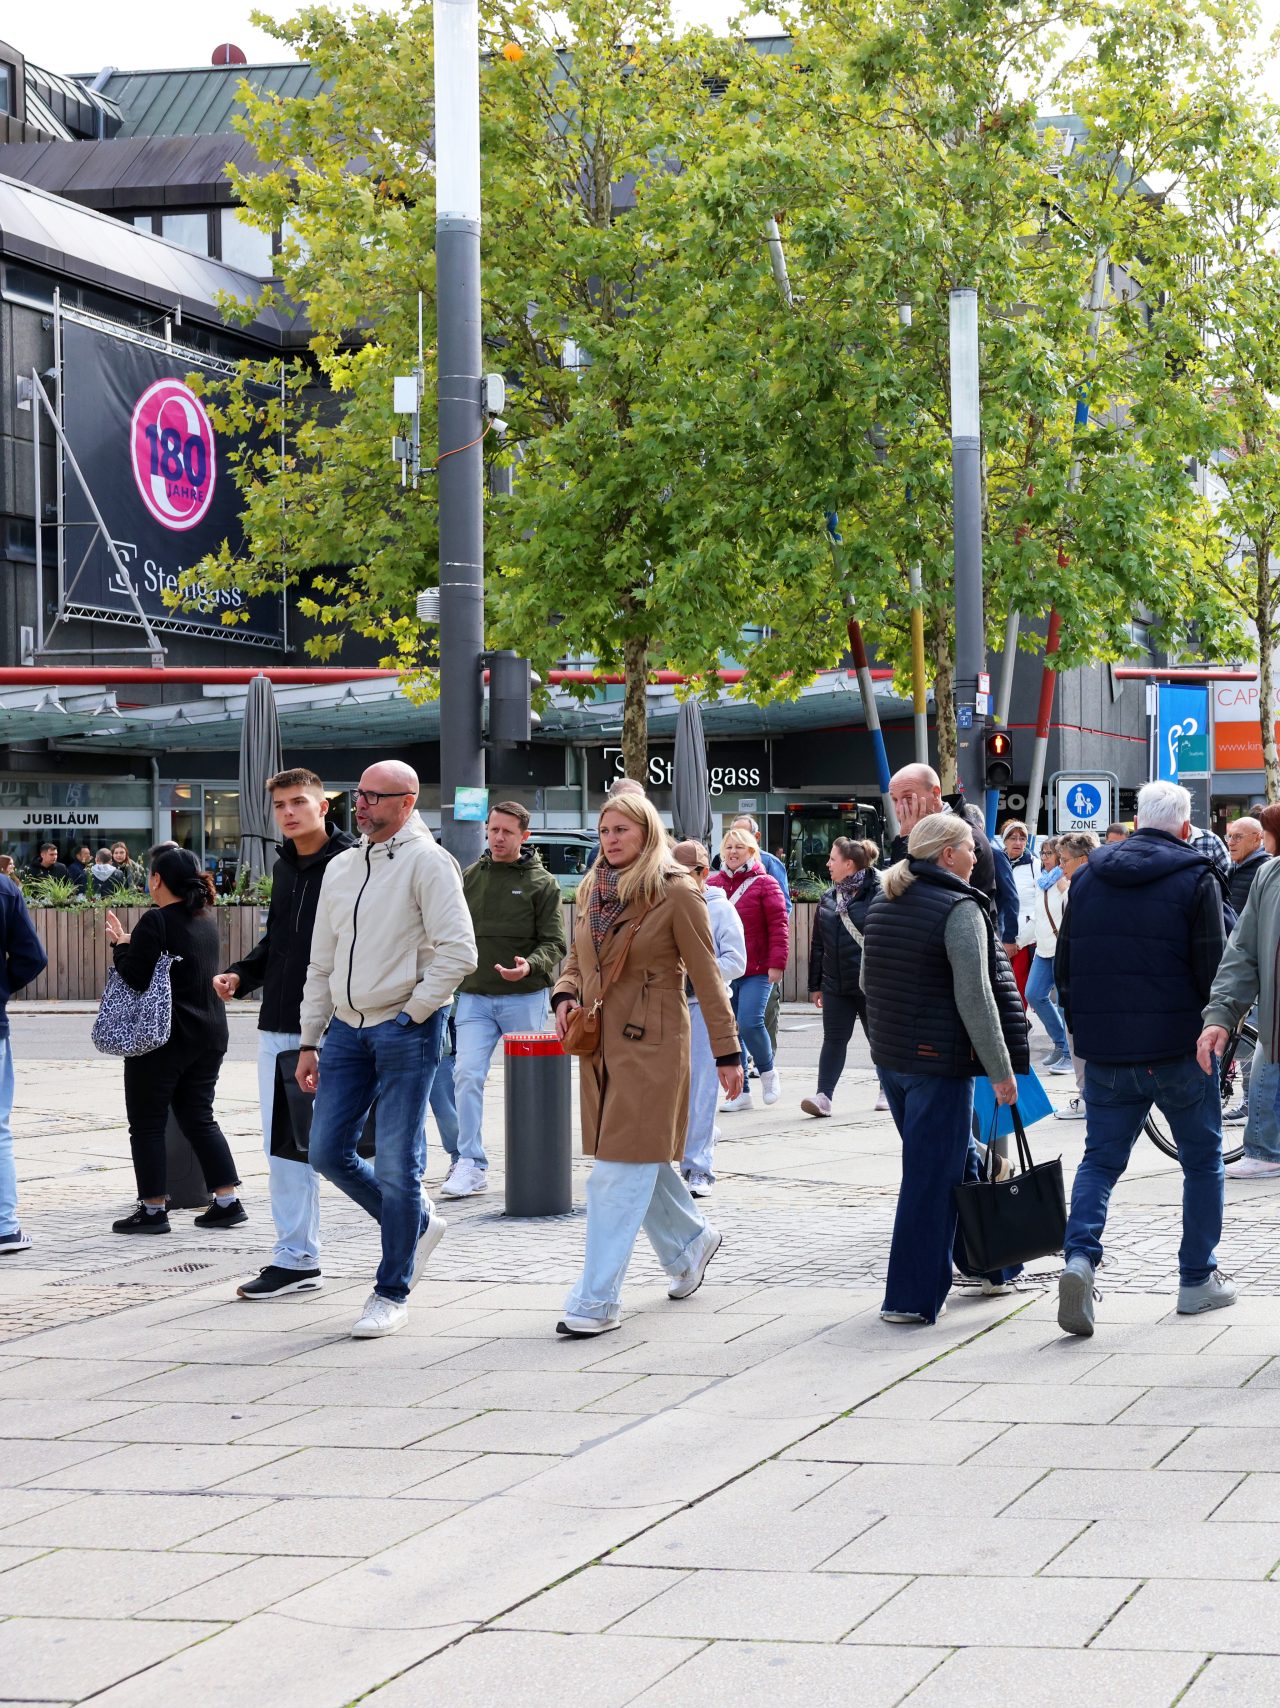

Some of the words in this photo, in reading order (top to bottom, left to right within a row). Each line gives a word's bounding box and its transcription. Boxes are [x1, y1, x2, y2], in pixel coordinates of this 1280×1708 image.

[145, 423, 207, 487] 180
[167, 483, 205, 503] JAHRE
[649, 756, 760, 796] Stgass
[22, 811, 99, 825] JUBILÄUM
[1070, 820, 1097, 829] ZONE
